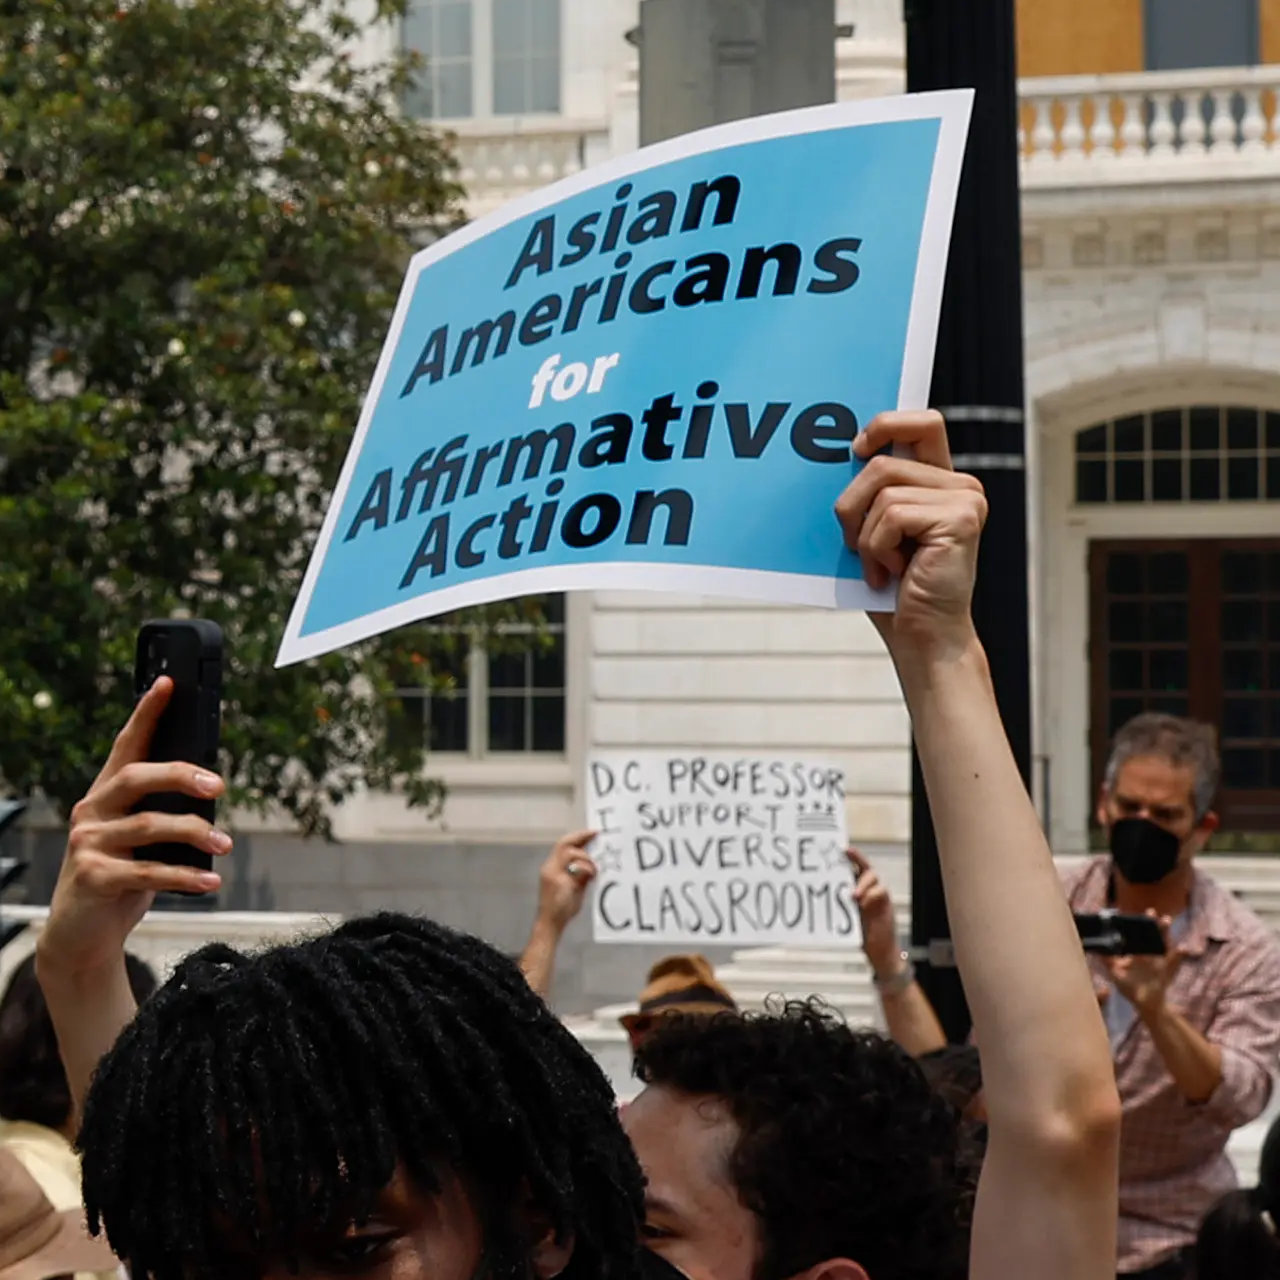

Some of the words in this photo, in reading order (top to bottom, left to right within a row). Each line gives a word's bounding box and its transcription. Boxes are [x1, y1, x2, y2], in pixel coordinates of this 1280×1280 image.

[503, 173, 741, 291] Asian
[400, 236, 863, 398] Americans
[528, 352, 620, 409] for
[343, 380, 859, 542] Affirmative
[398, 479, 694, 590] Action
[668, 757, 845, 799] PROFESSOR
[597, 806, 622, 834] I
[638, 802, 781, 833] SUPPORT
[634, 834, 819, 871] DIVERSE
[599, 878, 853, 935] CLASSROOMS
